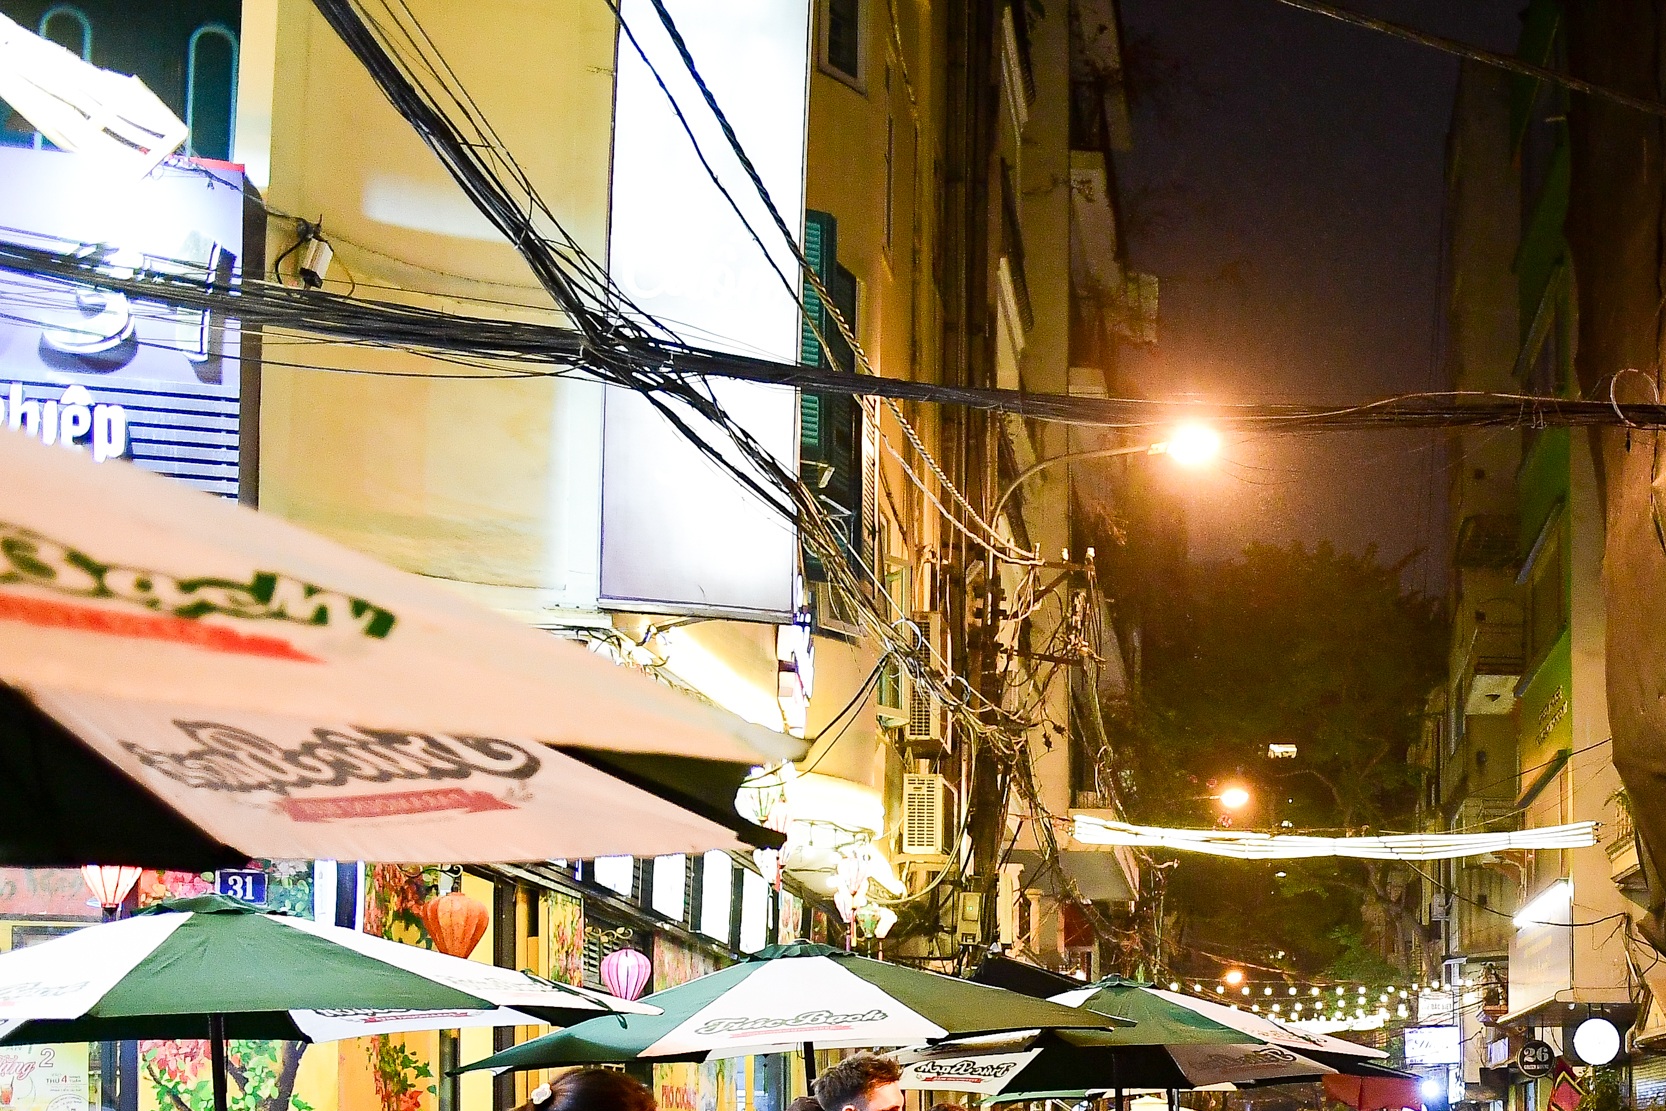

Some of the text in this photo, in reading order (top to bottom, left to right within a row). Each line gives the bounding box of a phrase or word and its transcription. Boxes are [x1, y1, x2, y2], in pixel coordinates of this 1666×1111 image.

[228, 875, 255, 901] 31
[39, 1047, 56, 1068] 2
[1523, 1046, 1549, 1063] 26
[61, 1075, 68, 1084] 4
